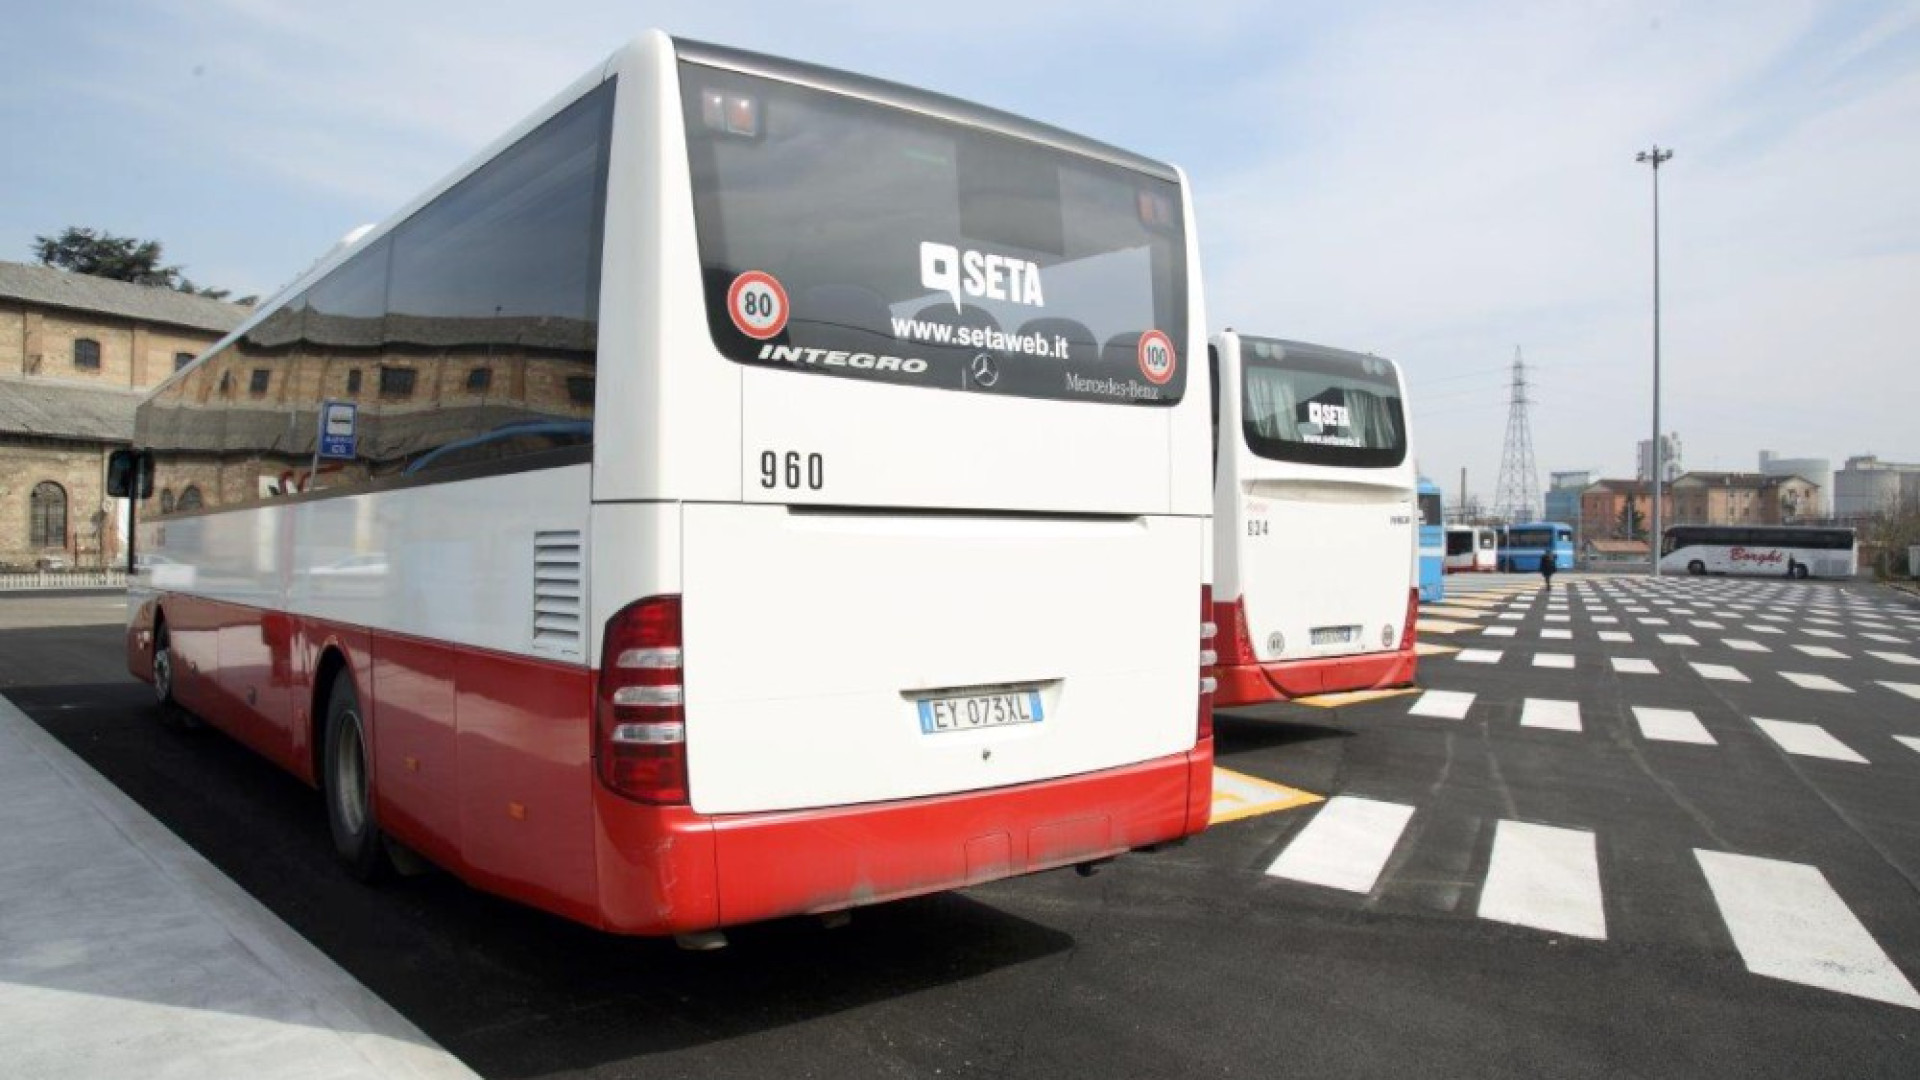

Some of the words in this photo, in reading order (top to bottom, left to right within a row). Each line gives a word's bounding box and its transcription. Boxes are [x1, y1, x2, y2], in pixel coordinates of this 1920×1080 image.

[962, 249, 1045, 308] SETA
[744, 291, 772, 317] 80
[890, 317, 1070, 360] www.setaweb.it
[758, 344, 929, 374] INTEGRO
[1147, 346, 1168, 367] 100
[1065, 372, 1159, 400] Mercedes-Benz
[760, 450, 823, 491] 960
[934, 701, 958, 728] EY
[967, 694, 1030, 724] 073XL
